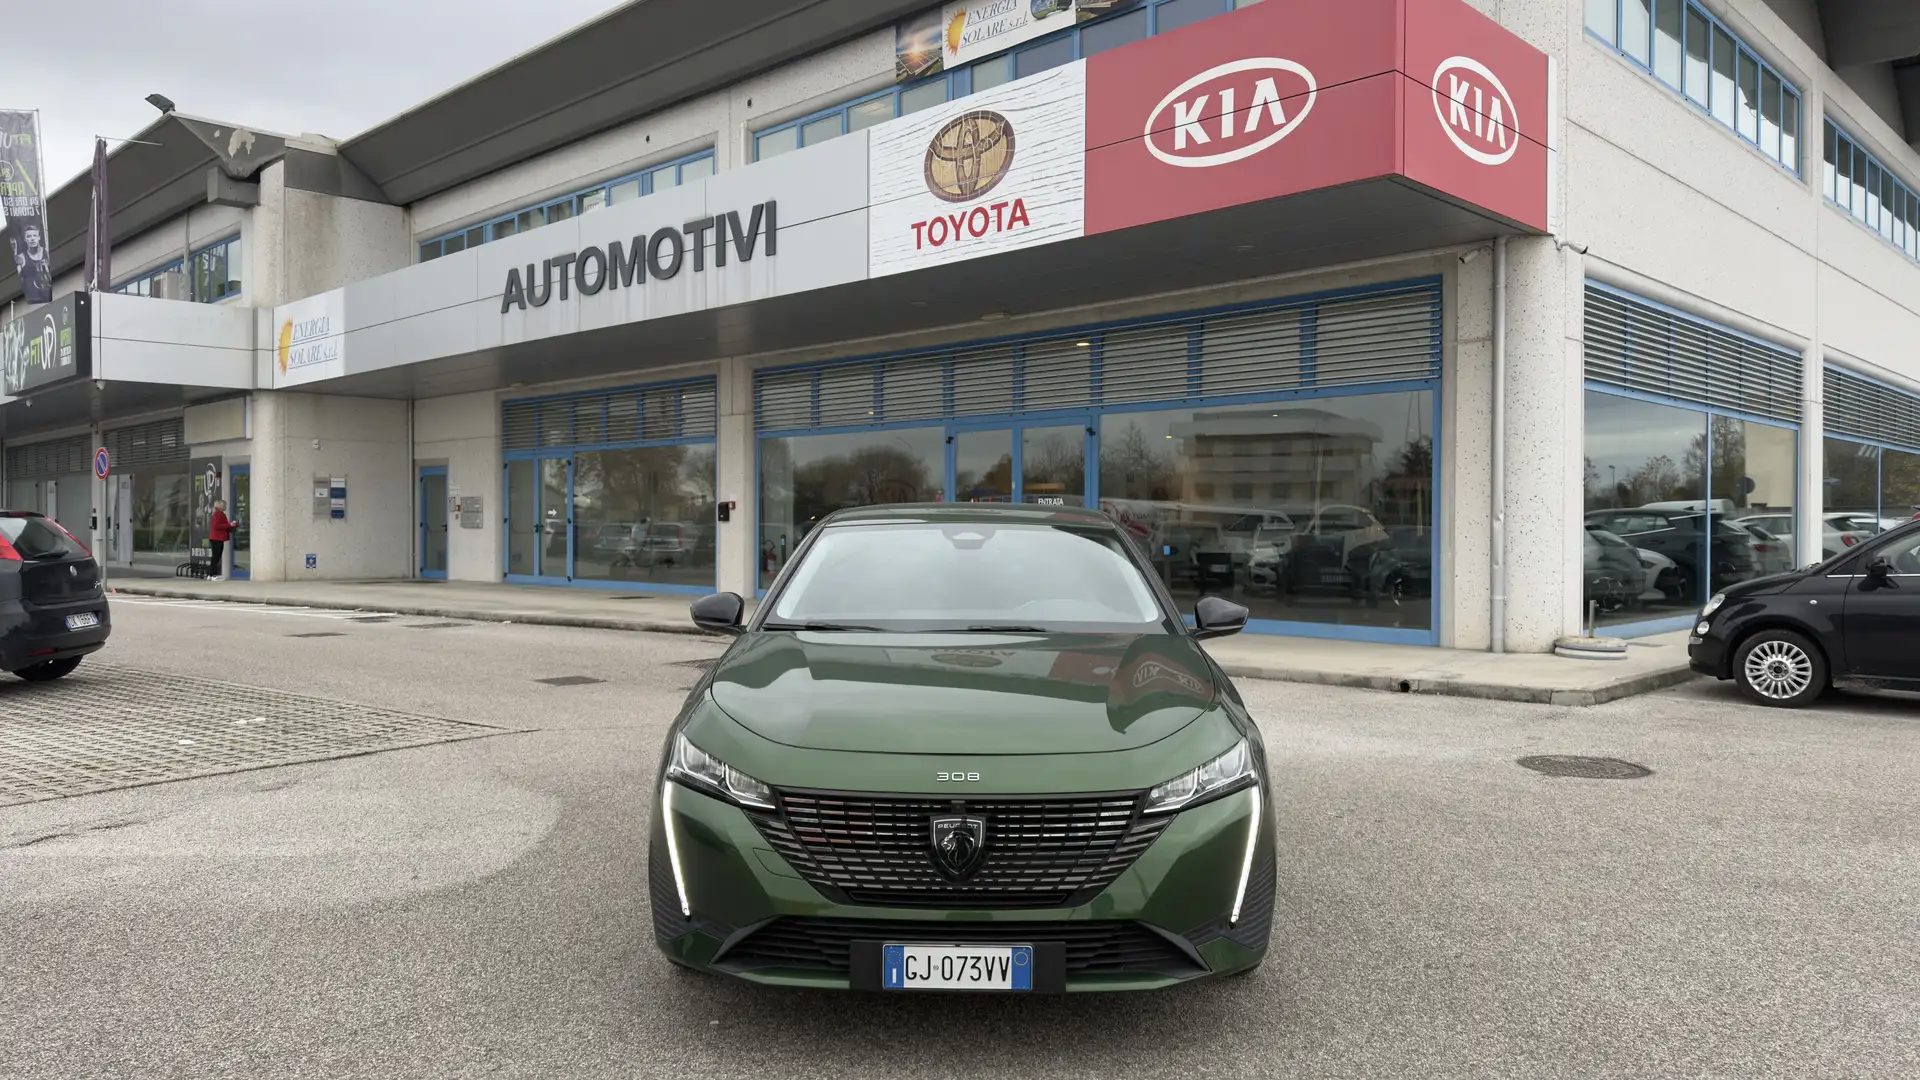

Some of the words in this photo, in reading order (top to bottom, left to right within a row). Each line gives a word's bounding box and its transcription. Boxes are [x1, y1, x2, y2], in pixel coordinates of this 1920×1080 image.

[961, 18, 1008, 45] SOLARE
[1172, 77, 1287, 151] KIA
[1448, 73, 1507, 150] KIA
[911, 198, 1030, 250] TOYOTA
[501, 200, 776, 313] AUTOMOTIVI
[293, 316, 329, 340] ENERGIA
[290, 344, 322, 367] SOLARE
[1038, 497, 1064, 506] ENTRATA
[937, 772, 980, 781] 308
[941, 956, 1010, 982] 073VV
